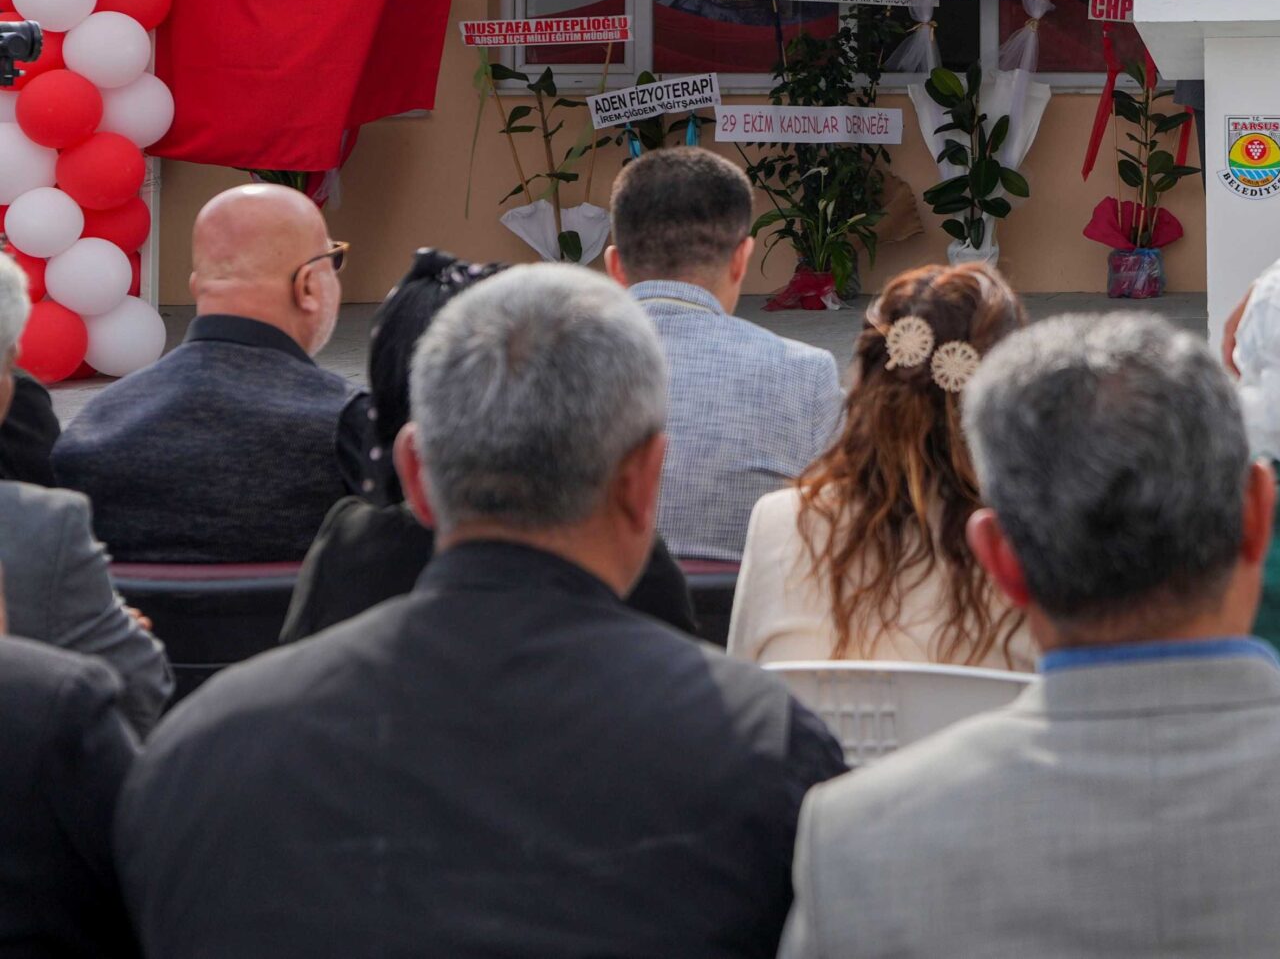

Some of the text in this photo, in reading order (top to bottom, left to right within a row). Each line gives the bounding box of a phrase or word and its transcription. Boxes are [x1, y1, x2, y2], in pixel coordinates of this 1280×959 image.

[464, 17, 627, 35] MUSTAFA ANTEPLİOĞLU
[507, 34, 526, 44] İLÇE
[595, 75, 714, 114] ADEN FİZYOTERAPİ
[600, 105, 657, 124] İREM-ÇİĞDEM
[722, 111, 889, 135] 29 EKİM KADINLAR DERNEĞİ
[1232, 122, 1280, 130] TARSUS
